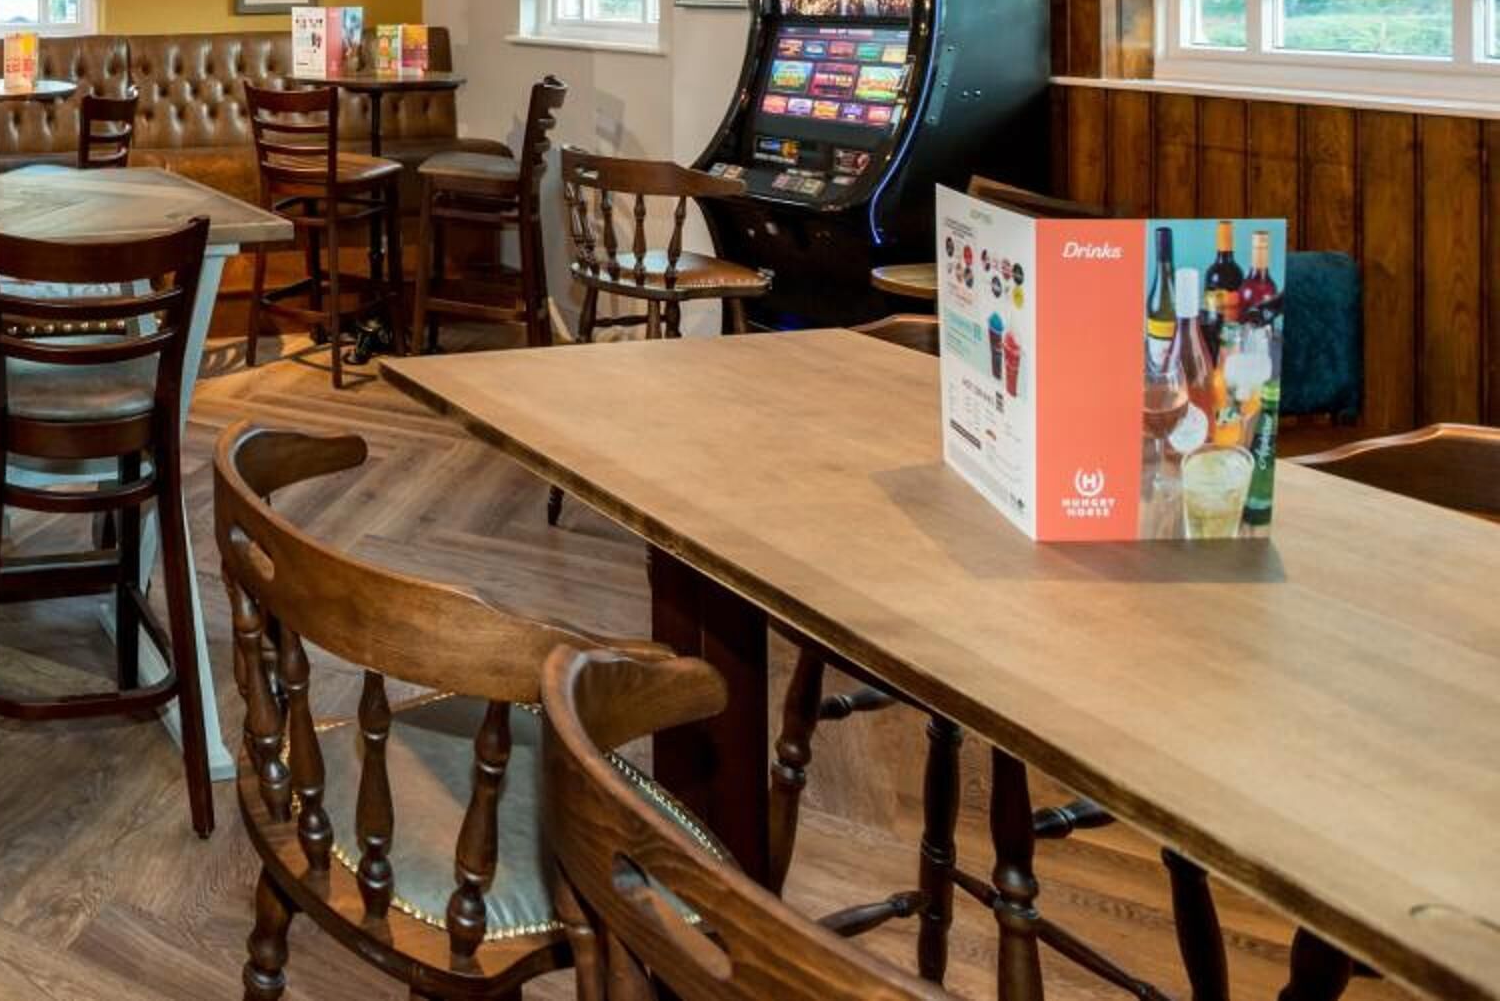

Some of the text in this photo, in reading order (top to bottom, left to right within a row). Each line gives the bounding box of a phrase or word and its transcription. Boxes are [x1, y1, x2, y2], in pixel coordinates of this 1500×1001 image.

[1062, 241, 1122, 259] Drinks
[1062, 498, 1115, 507] HUNGRY
[1067, 508, 1111, 517] HORSE
